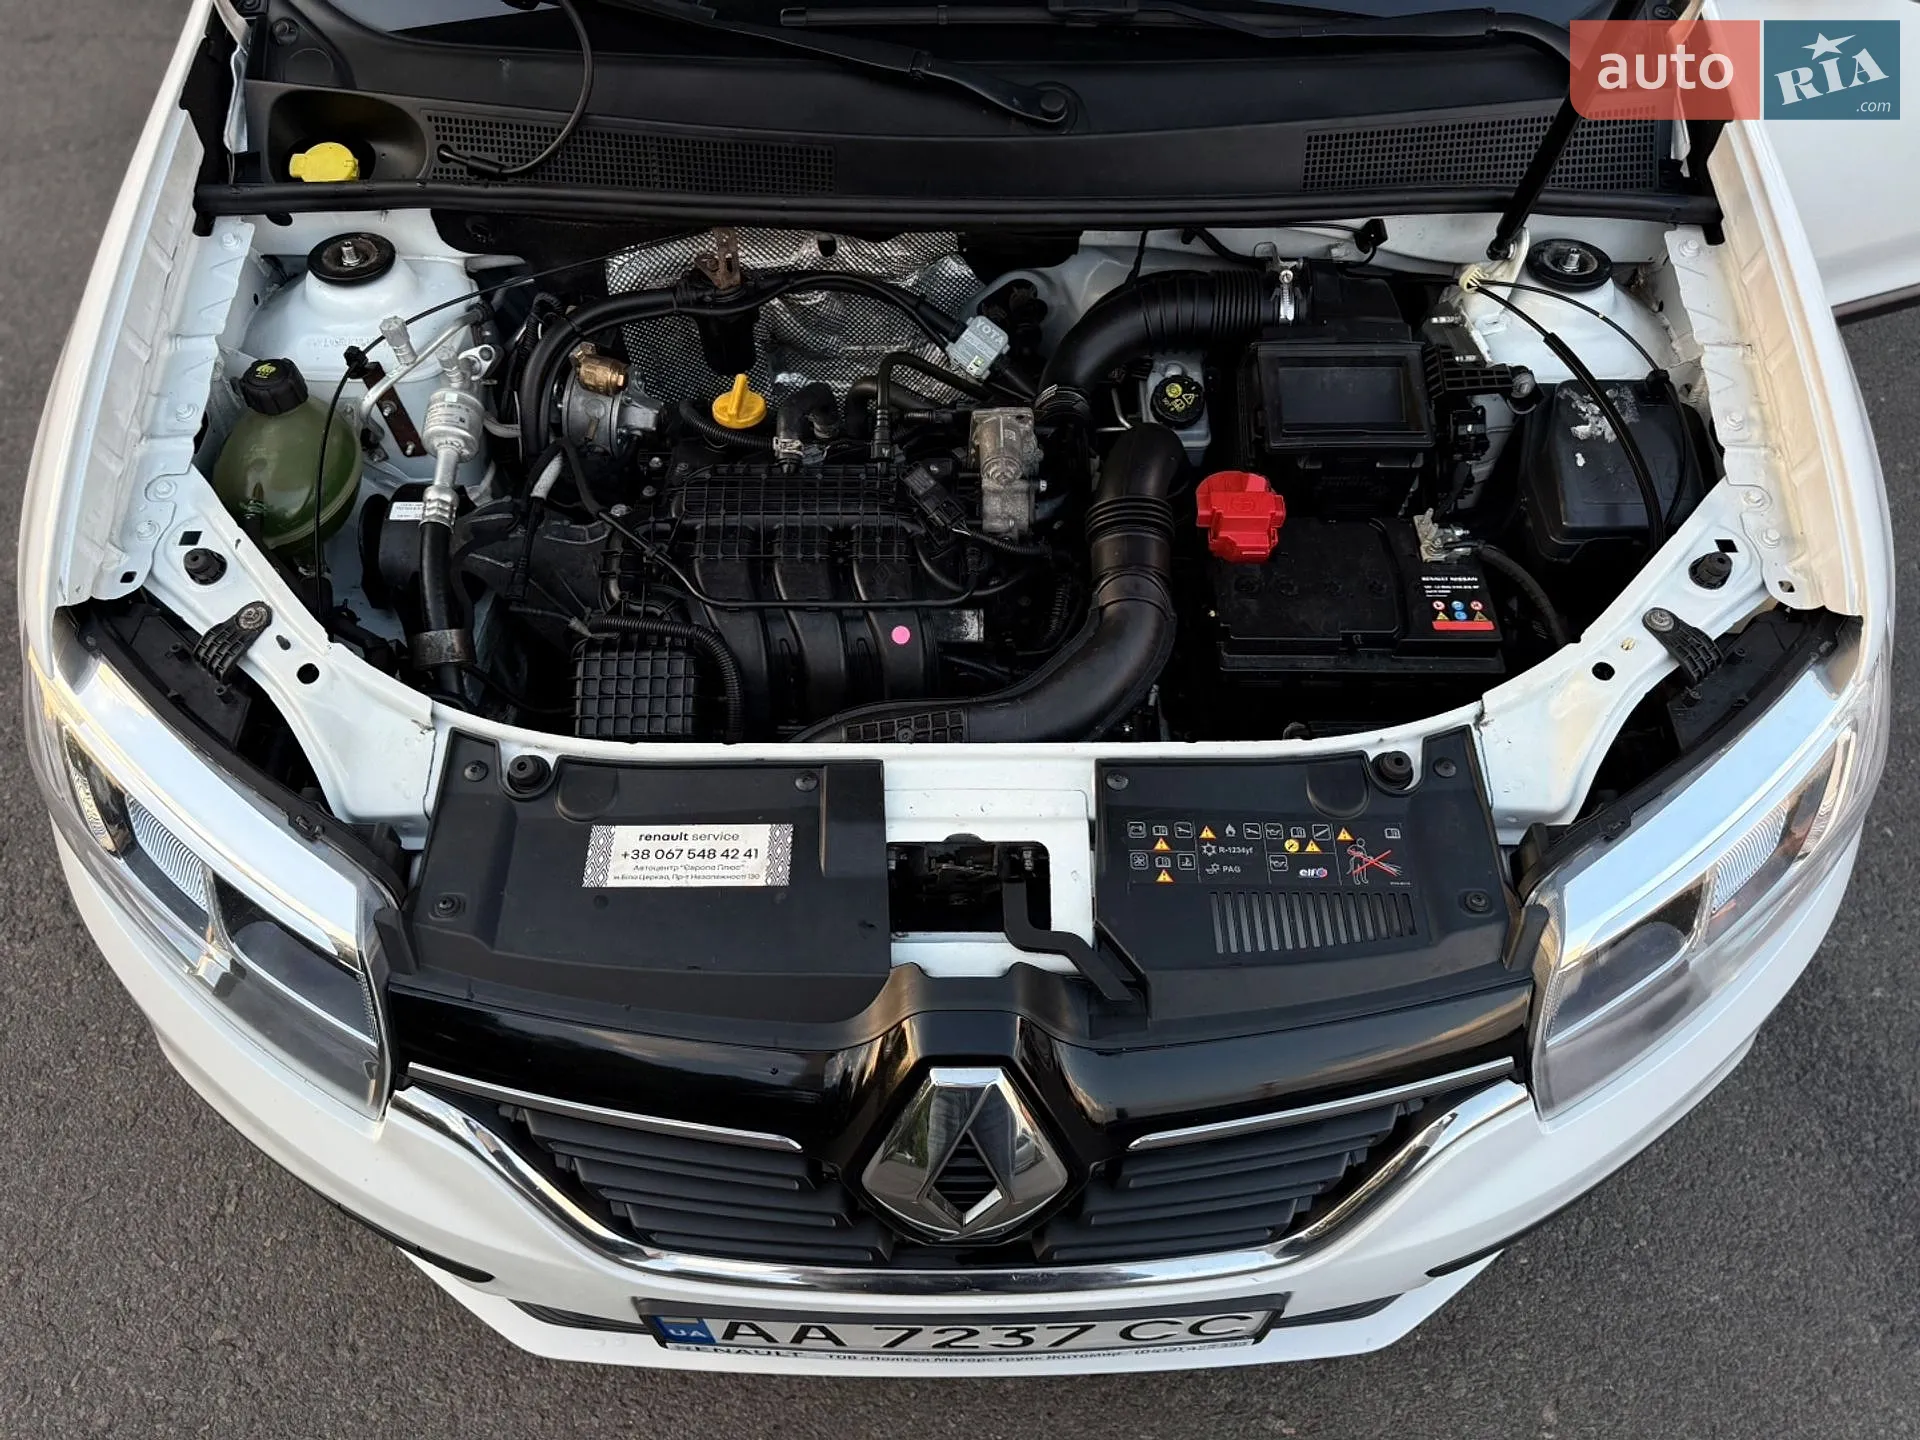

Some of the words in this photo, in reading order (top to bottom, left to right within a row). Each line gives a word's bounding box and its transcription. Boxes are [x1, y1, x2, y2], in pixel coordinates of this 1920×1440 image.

[638, 831, 689, 842] renault
[691, 831, 740, 842] service
[621, 848, 651, 860] +38
[654, 848, 684, 860] 067
[687, 848, 717, 860] 548
[720, 848, 740, 860] 42
[742, 848, 759, 860] 41
[1222, 865, 1241, 873] PAG
[668, 1328, 707, 1338] UA
[721, 1320, 848, 1347] AA
[873, 1324, 1097, 1349] 7237
[1118, 1314, 1254, 1341] CC
